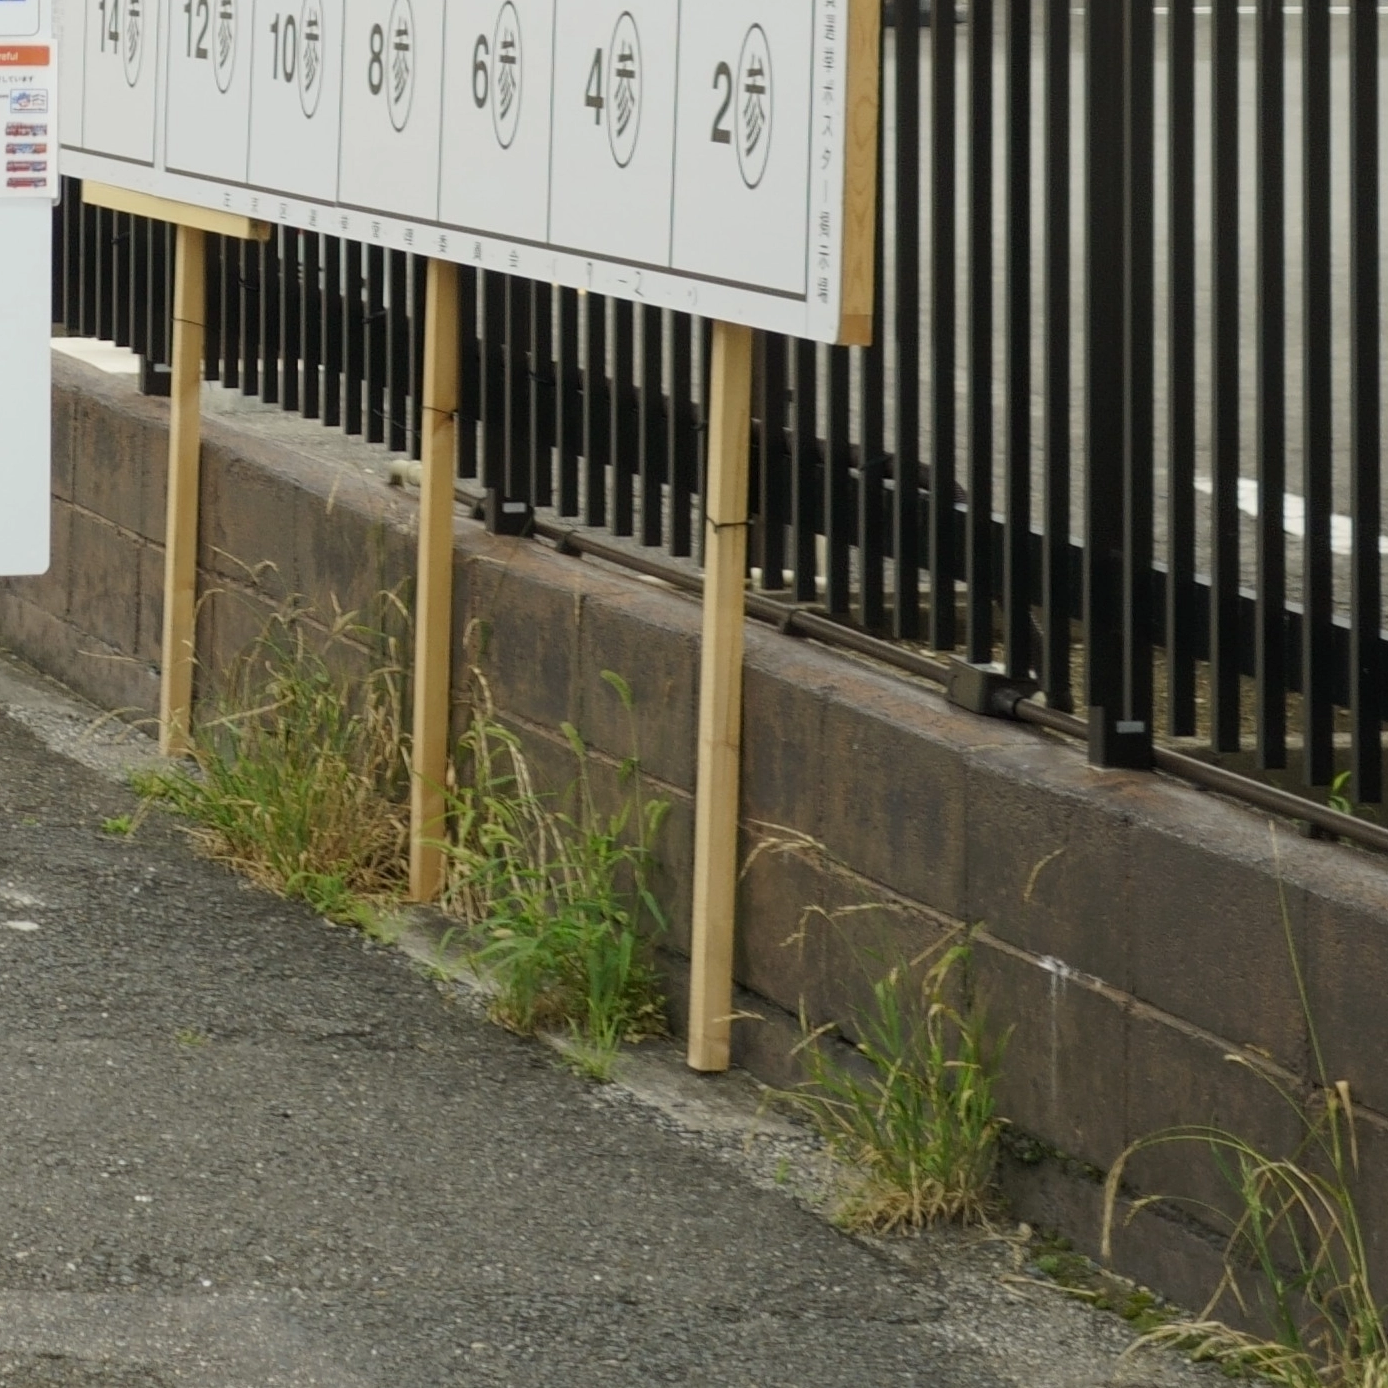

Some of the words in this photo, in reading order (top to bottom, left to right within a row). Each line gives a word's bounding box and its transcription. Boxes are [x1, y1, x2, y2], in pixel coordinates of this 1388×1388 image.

[270, 13, 296, 83] 10
[368, 23, 384, 96] 8
[472, 34, 489, 109] 6
[584, 47, 604, 126] 4
[710, 61, 732, 145] 2
